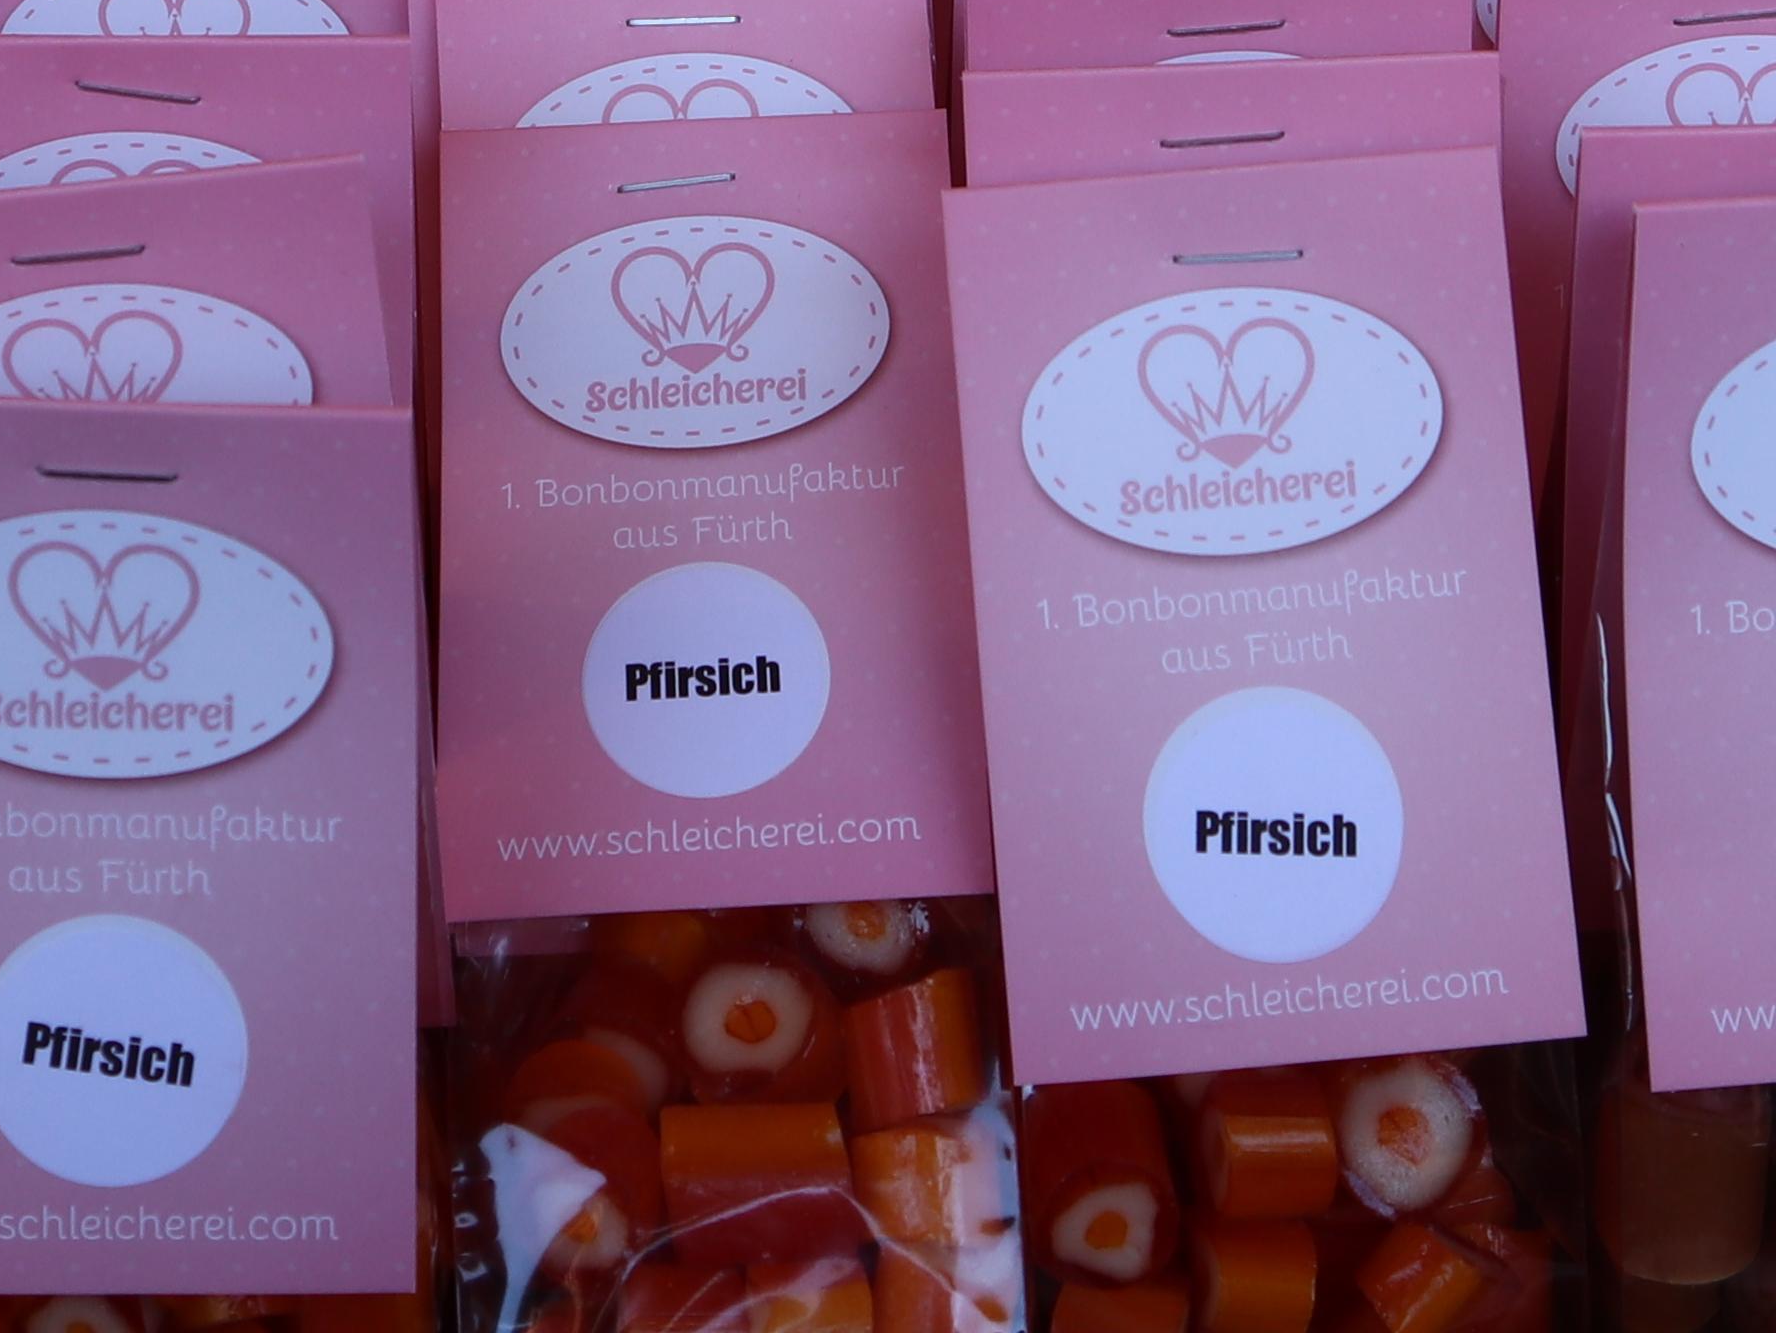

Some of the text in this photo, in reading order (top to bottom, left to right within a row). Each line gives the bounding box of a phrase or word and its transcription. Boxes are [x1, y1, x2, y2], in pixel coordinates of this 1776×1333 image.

[585, 367, 809, 414] Schleicherei
[500, 460, 907, 511] 1. Bonbonmanufaktur
[1119, 459, 1359, 517] Schleicherei
[612, 511, 794, 551] aus Fürth
[1036, 565, 1470, 633] 1. Bonbonmanufaktur
[1690, 604, 1711, 637] 1.
[1161, 629, 1353, 676] aus Fürth
[624, 654, 782, 703] Pfirsich
[497, 813, 923, 863] www.schleicherei.com
[1194, 808, 1358, 859] Pfirsich
[7, 857, 213, 897] aus Fürth
[1070, 965, 1511, 1033] www.schleicherei.com
[23, 1020, 197, 1087] Pfirsich
